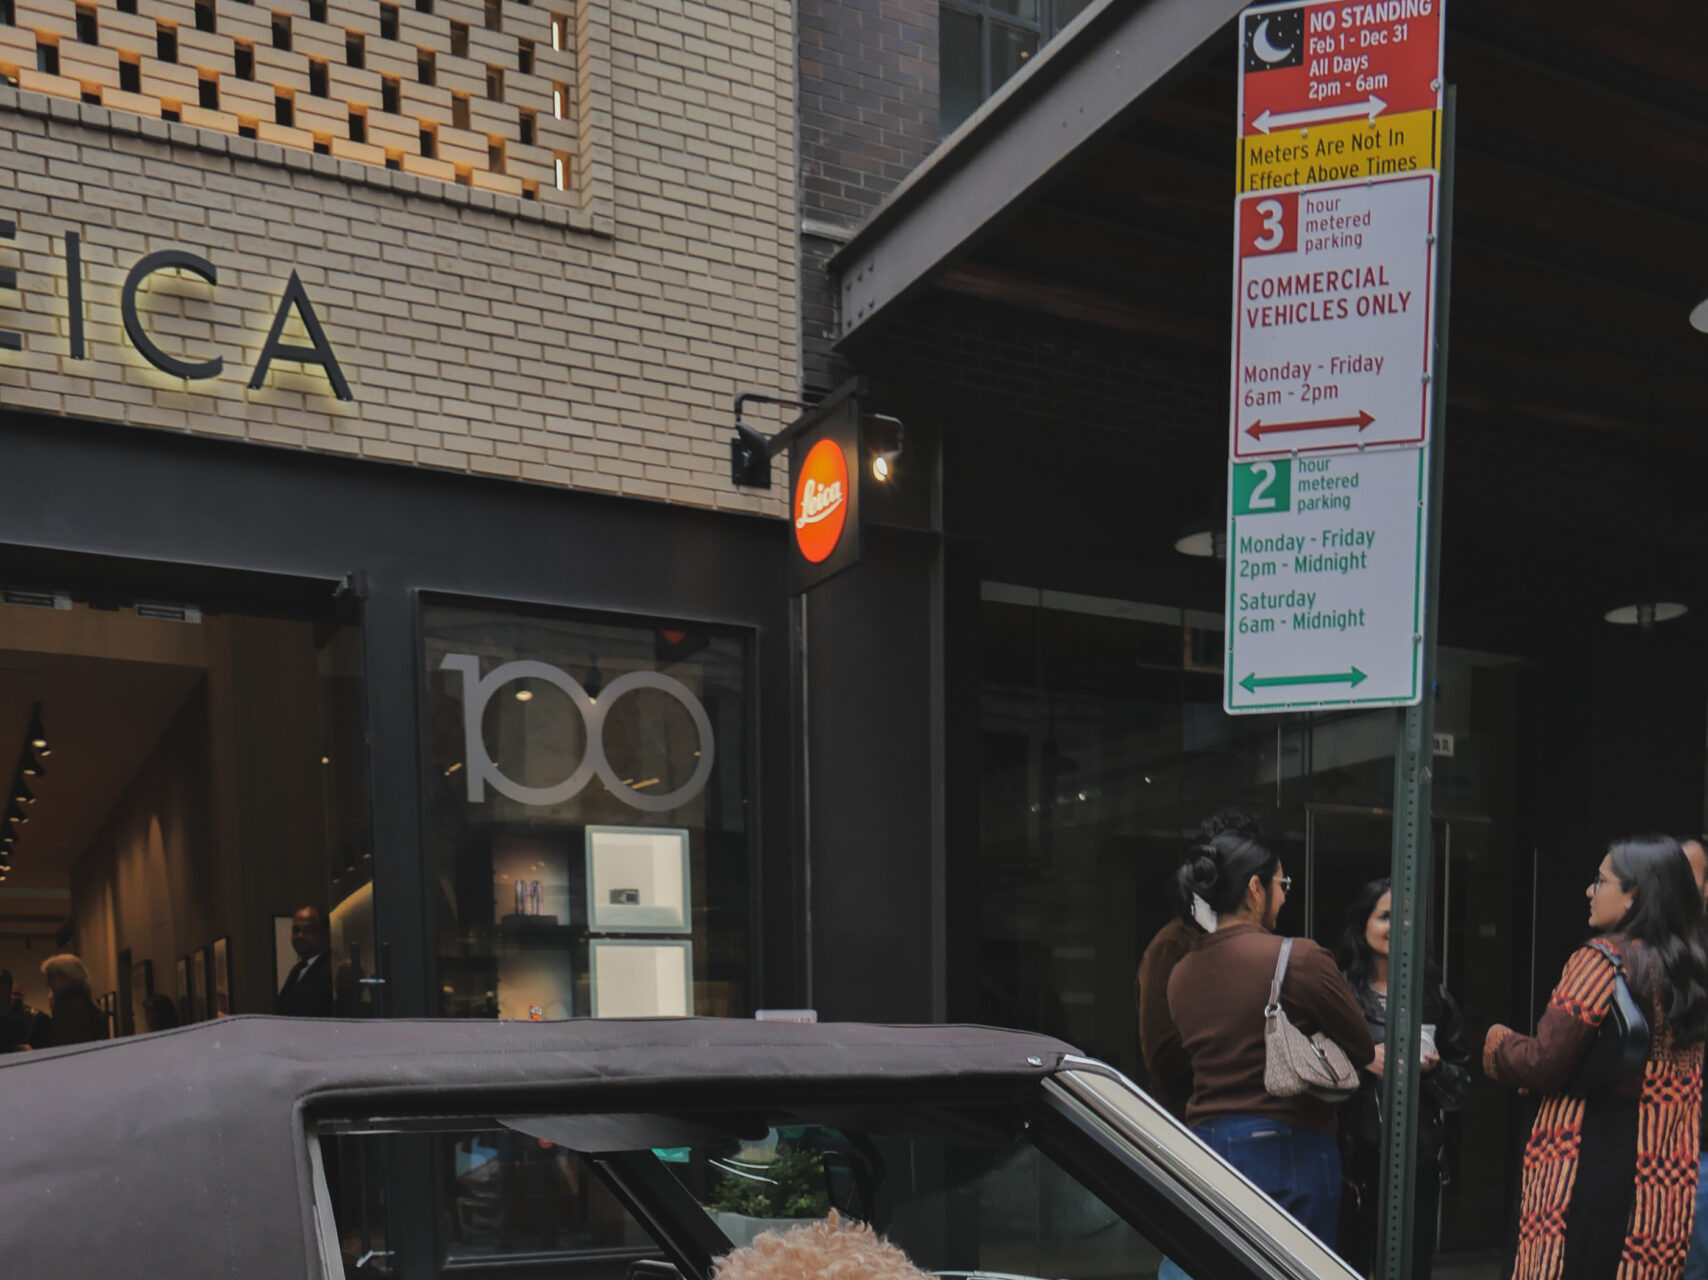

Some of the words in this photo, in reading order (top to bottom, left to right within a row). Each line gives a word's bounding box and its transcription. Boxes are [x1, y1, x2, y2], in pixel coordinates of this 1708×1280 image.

[1309, 12, 1335, 34] NO
[1341, 0, 1432, 29] STANDING
[1309, 36, 1334, 55] Feb
[1339, 34, 1345, 50] 1
[1360, 29, 1388, 48] Dec
[1392, 24, 1408, 42] 31
[1309, 58, 1329, 77] All
[1333, 55, 1369, 74] Days
[1308, 81, 1341, 101] 2pm
[1355, 74, 1388, 92] 6am
[1250, 143, 1309, 166] Meters
[1315, 138, 1345, 157] Are
[1351, 133, 1382, 151] Not
[1389, 128, 1404, 147] In
[1250, 170, 1299, 192] Effect
[1306, 164, 1359, 184] Above
[1367, 155, 1418, 176] Times
[1306, 198, 1341, 214] hour
[1253, 199, 1284, 251] 3
[1305, 210, 1371, 233] metered
[1305, 231, 1363, 255] parking
[1247, 265, 1389, 300] COMMERCIAL
[1247, 298, 1349, 329] VEHICLES
[1356, 290, 1412, 317] ONLY
[1244, 362, 1312, 384] Monday
[1330, 354, 1384, 376] Friday
[1244, 389, 1282, 408] 6am
[1301, 383, 1339, 404] 2pm
[1299, 457, 1331, 473] hour
[1248, 461, 1276, 510] 2
[1298, 472, 1360, 493] metered
[795, 478, 844, 529] Leica
[1298, 493, 1351, 515] parking
[1239, 533, 1305, 554] Monday
[1322, 528, 1375, 550] Friday
[1239, 560, 1277, 581] 2pm
[1294, 550, 1367, 576] Midnight
[1239, 589, 1317, 612] Saturday
[1238, 616, 1275, 634] 6am
[1293, 608, 1366, 632] Midnight
[439, 653, 715, 812] 100
